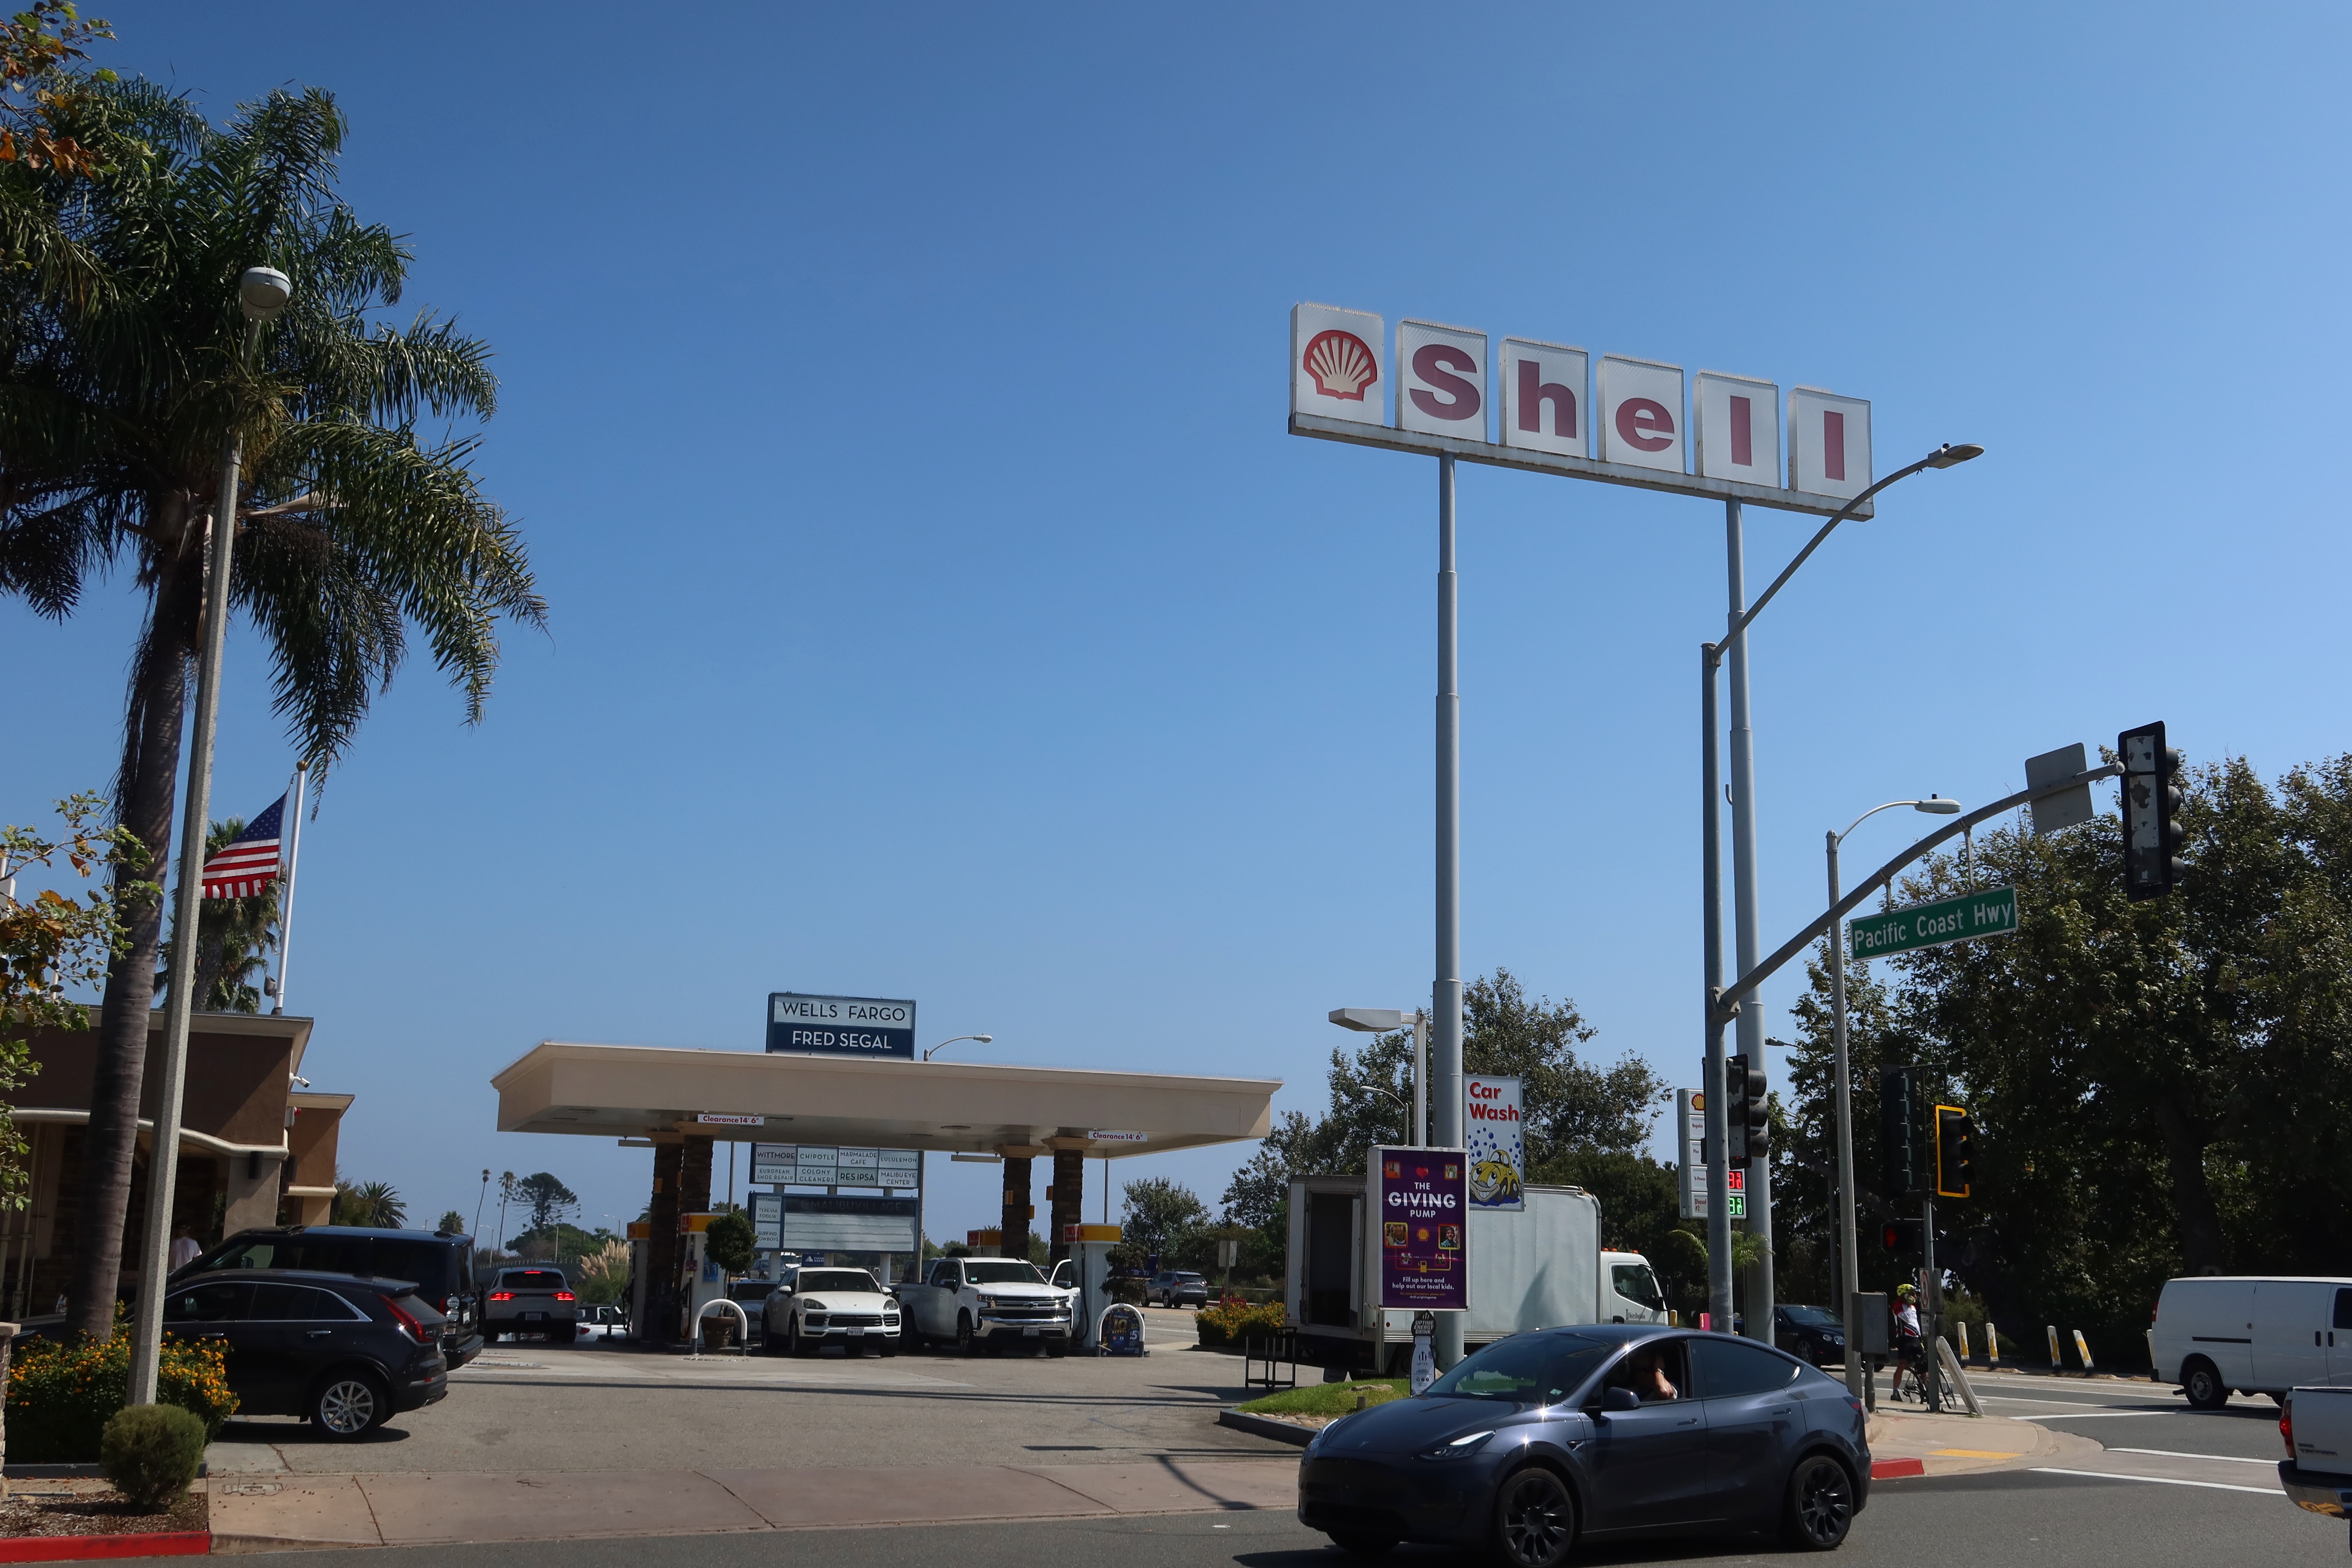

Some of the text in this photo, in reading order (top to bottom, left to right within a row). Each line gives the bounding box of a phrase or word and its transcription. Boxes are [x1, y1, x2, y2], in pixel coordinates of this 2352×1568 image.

[1409, 344, 1845, 481] Shell
[1854, 903, 2012, 950] Pacific Coast Hwy
[782, 1002, 906, 1021] WELLS FARGO
[792, 1030, 892, 1049] FRED SEGAL
[1469, 1081, 1502, 1099] Car
[703, 1115, 739, 1124] Clearance
[1469, 1103, 1519, 1121] Wash
[1093, 1131, 1125, 1140] Clearance
[757, 1151, 795, 1159] WITTMORE
[856, 1173, 875, 1182] IPSA
[1414, 1182, 1430, 1190] THE
[1388, 1191, 1456, 1209] GIVING
[1410, 1209, 1436, 1218] PUMP
